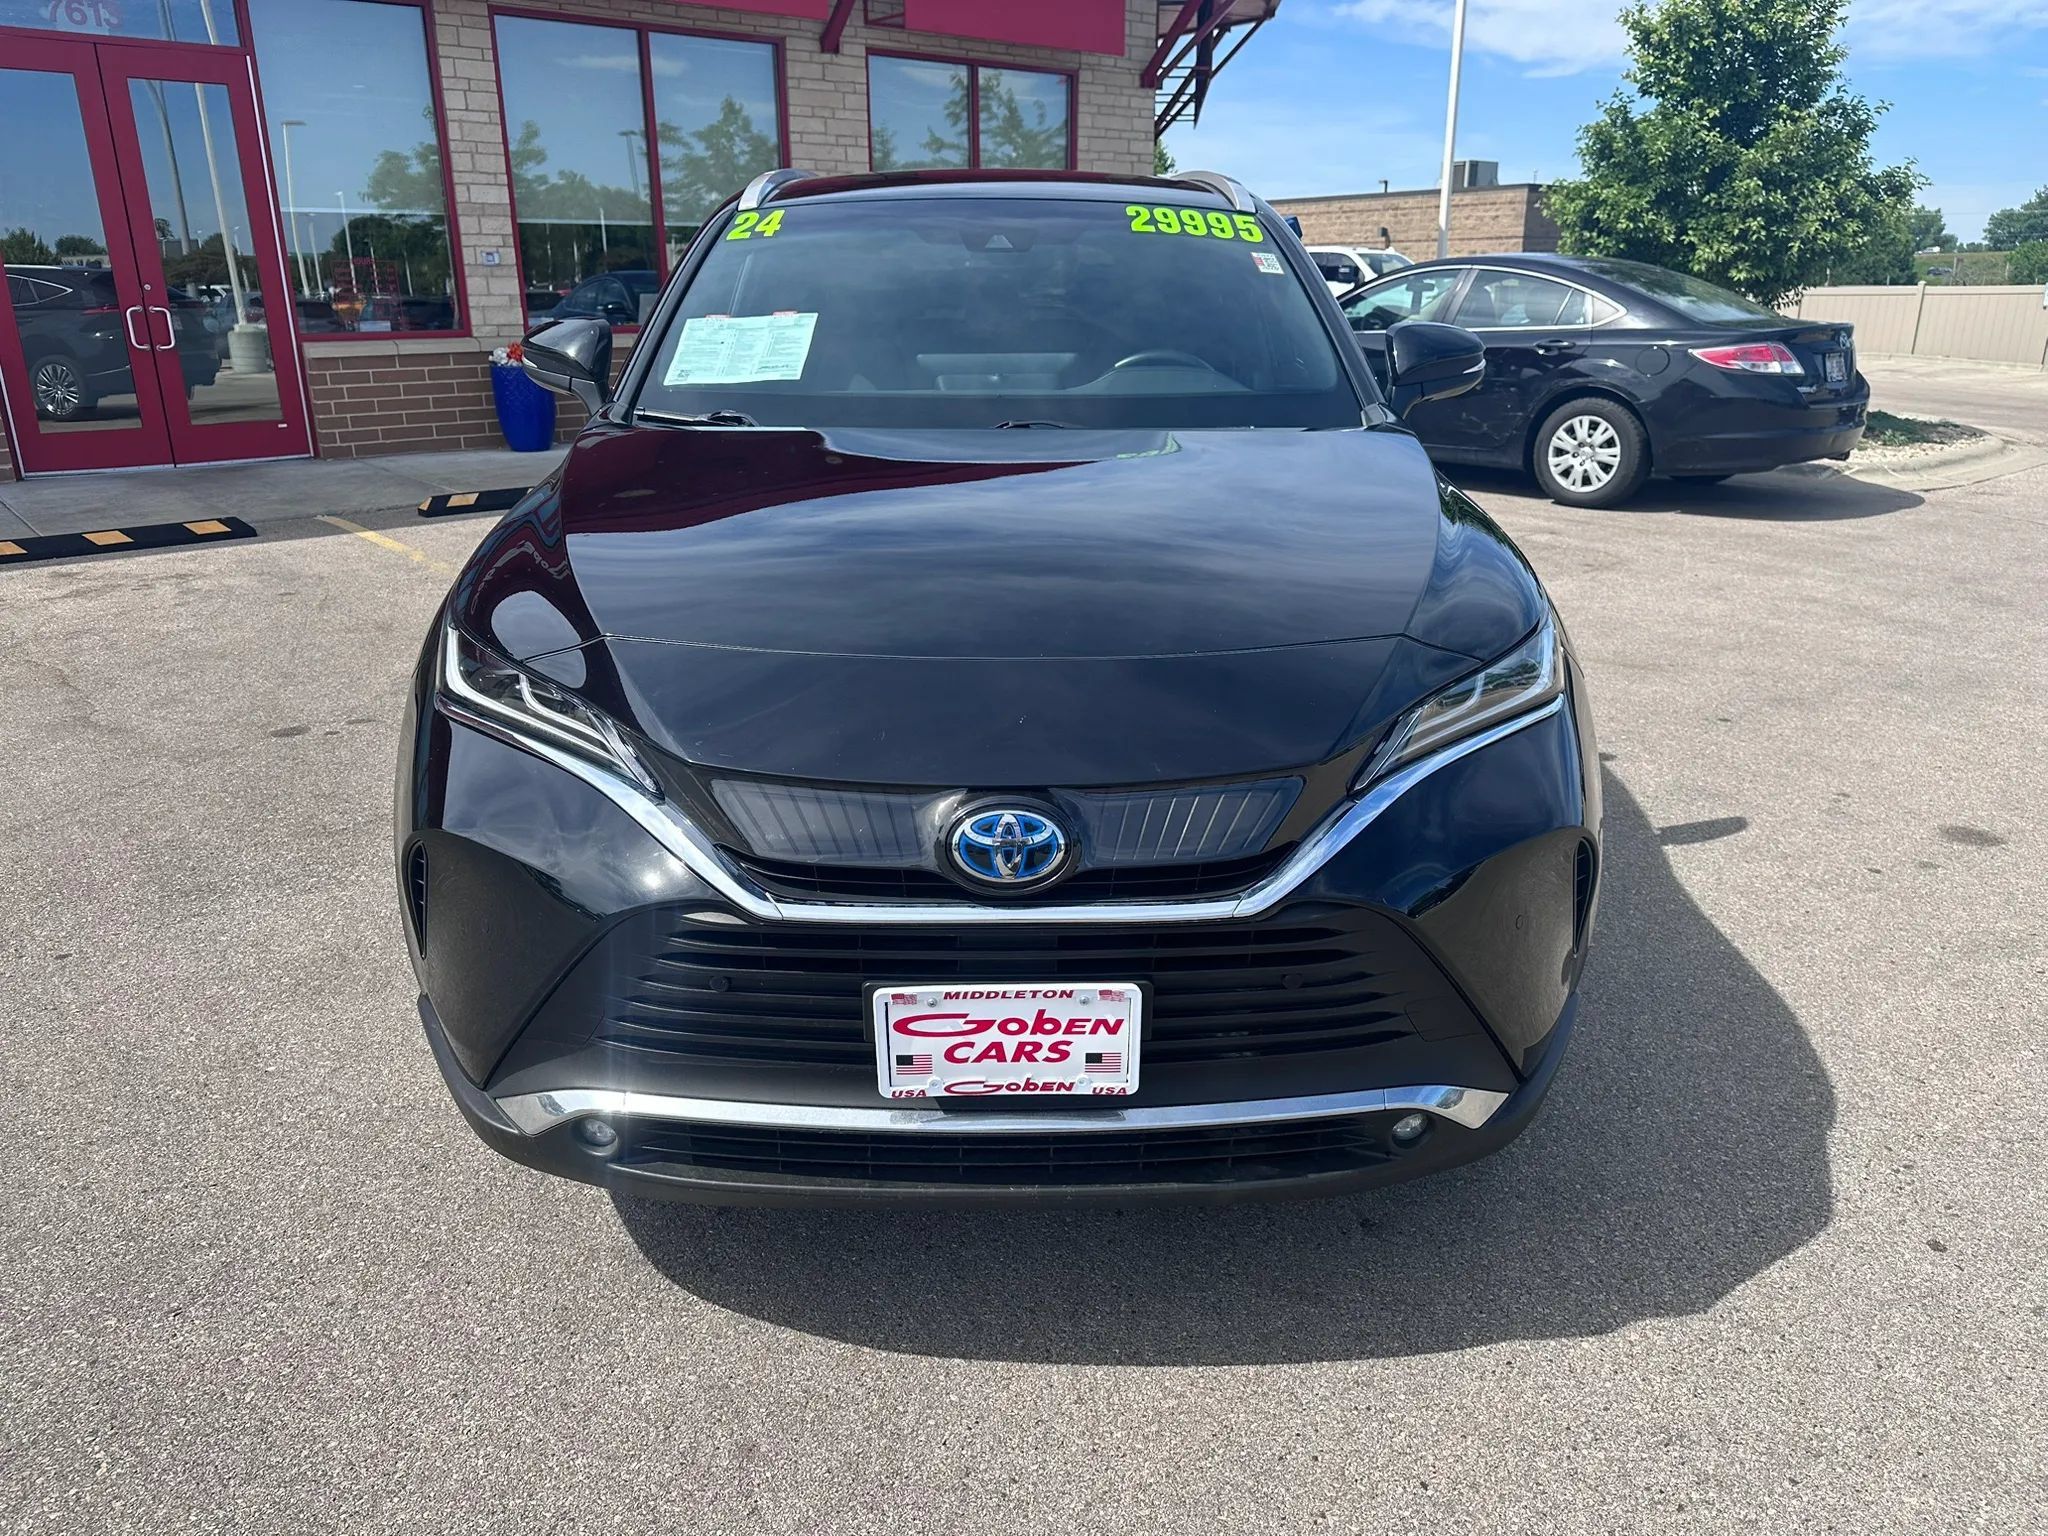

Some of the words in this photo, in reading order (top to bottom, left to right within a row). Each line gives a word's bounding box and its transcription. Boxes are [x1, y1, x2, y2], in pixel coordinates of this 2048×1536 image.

[726, 209, 786, 241] 24
[1125, 205, 1264, 243] 29995
[943, 989, 1075, 1001] MIDDLETON
[943, 1040, 1075, 1064] CARS
[890, 1088, 928, 1099] USA
[1091, 1086, 1128, 1097] USA
